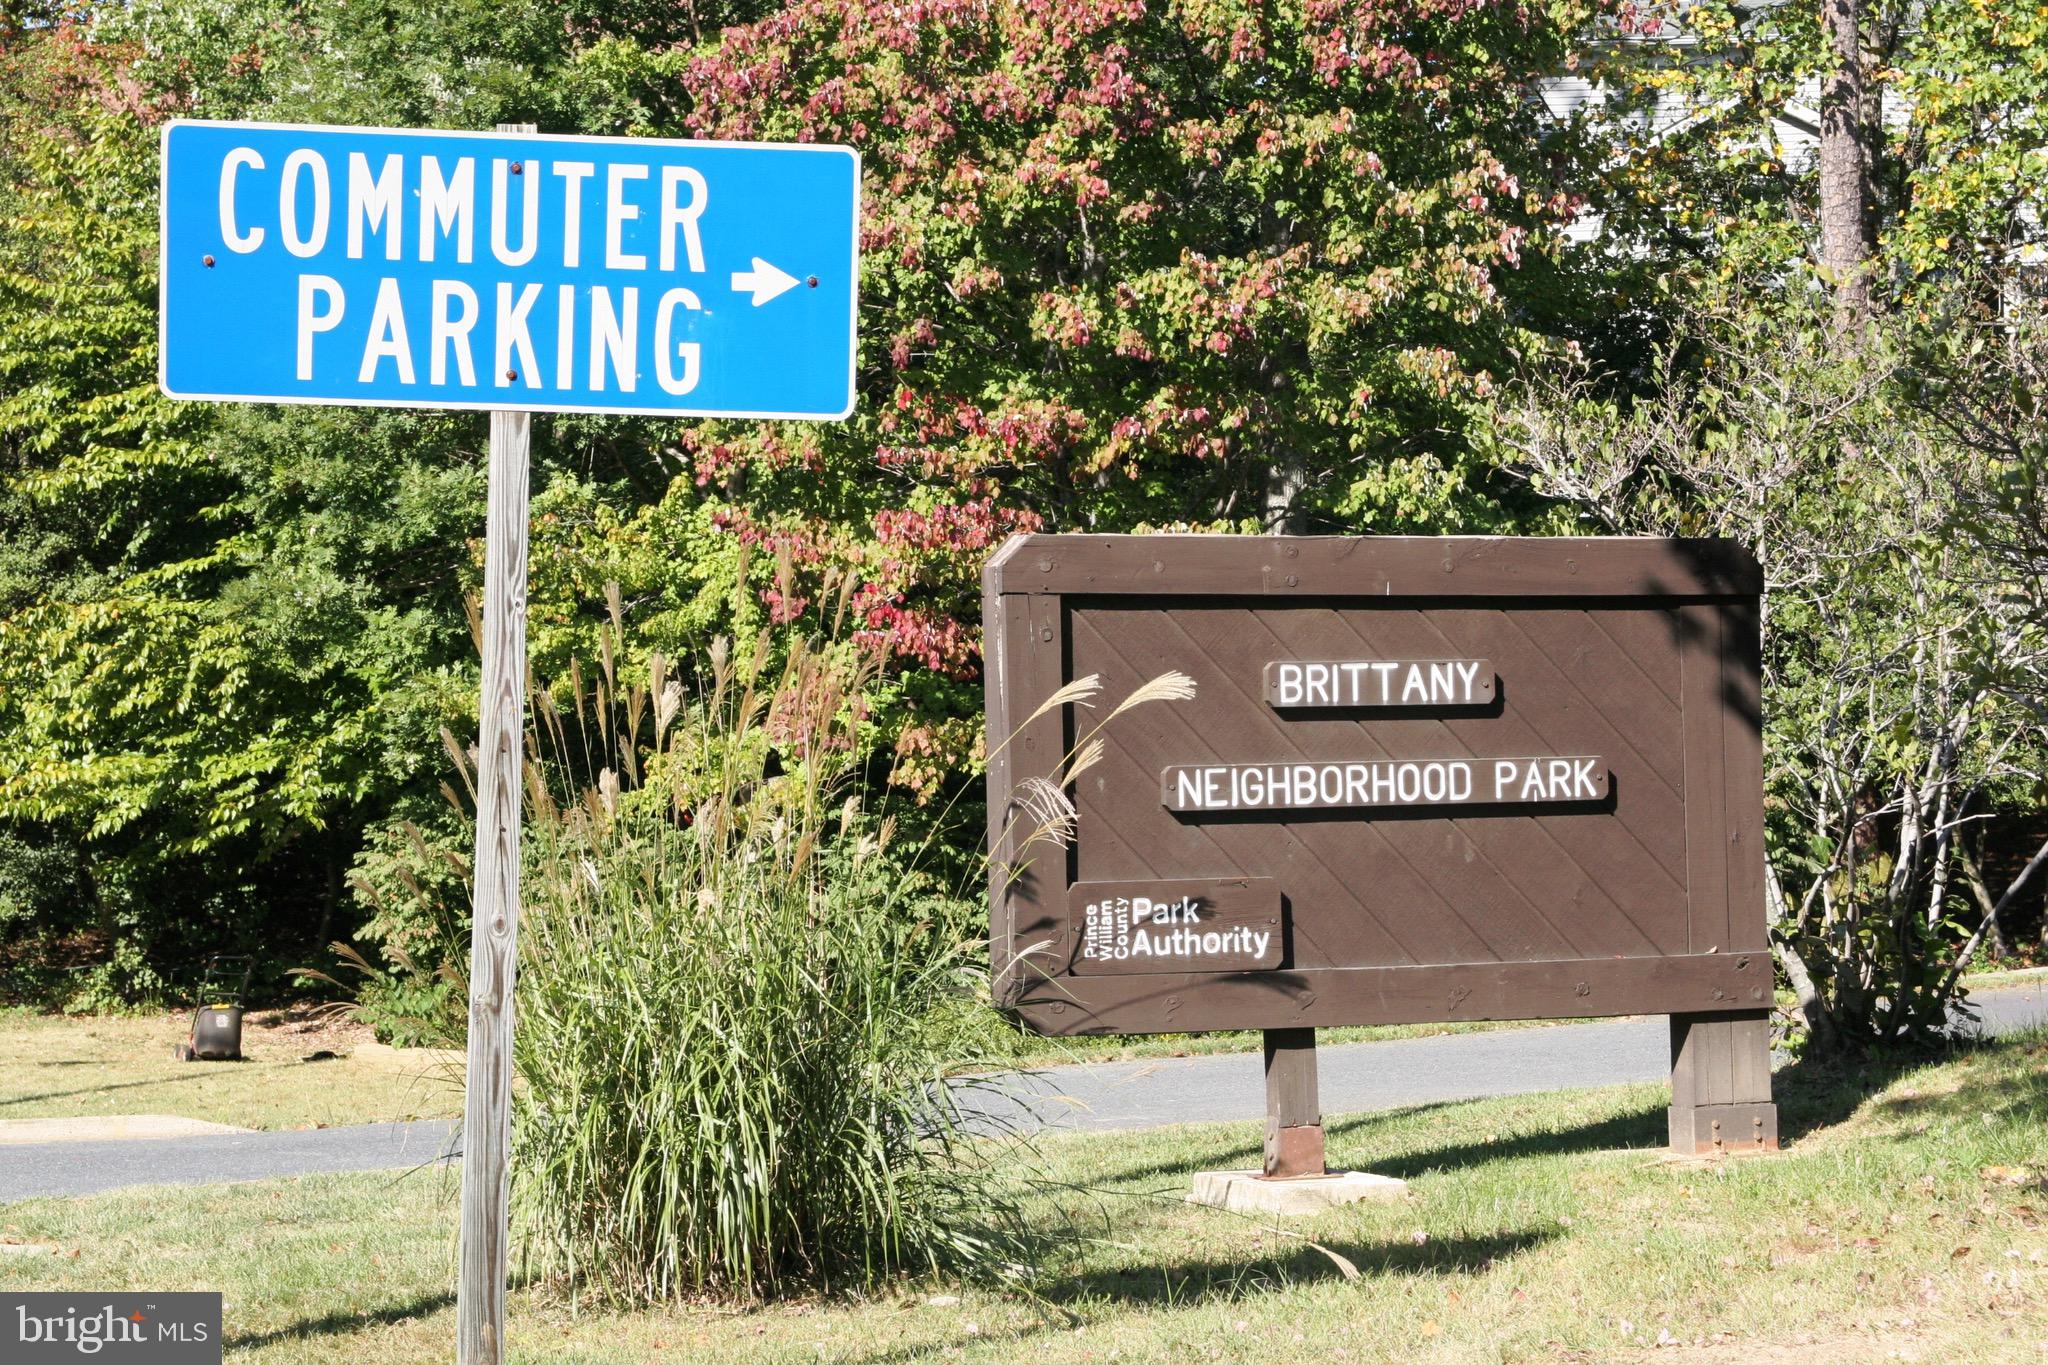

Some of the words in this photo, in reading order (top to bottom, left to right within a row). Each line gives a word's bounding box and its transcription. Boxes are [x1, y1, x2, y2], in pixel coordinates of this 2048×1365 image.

[219, 147, 708, 272] COMMUTER
[297, 274, 702, 396] PARKING
[1279, 662, 1478, 703] BRITTANY
[1177, 762, 1472, 808] NEIGHBORHOOD
[1495, 759, 1597, 801] PARK
[1084, 903, 1097, 958] Prince
[1099, 900, 1113, 961] William
[1114, 897, 1129, 959] County
[1132, 896, 1200, 925] Park
[1131, 926, 1270, 959] Authority
